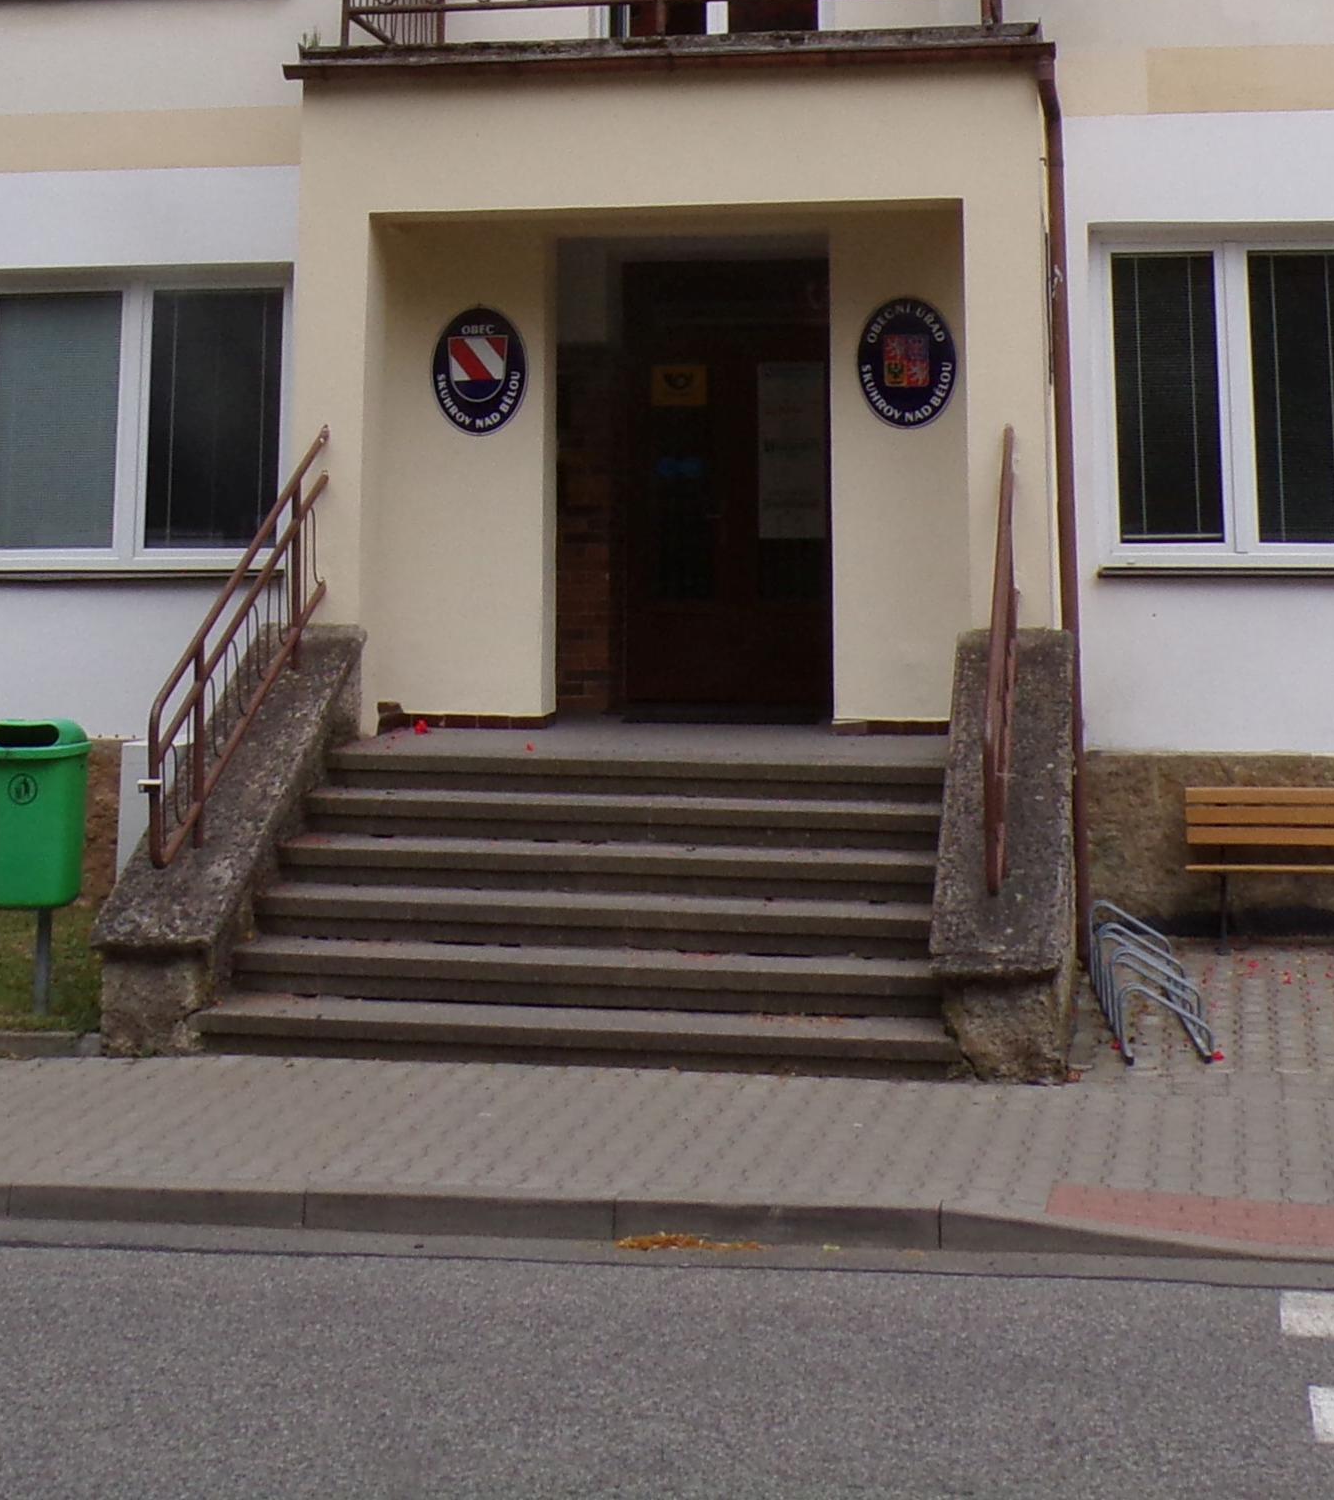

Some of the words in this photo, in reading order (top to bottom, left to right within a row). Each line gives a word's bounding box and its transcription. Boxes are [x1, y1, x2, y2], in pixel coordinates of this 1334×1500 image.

[461, 324, 495, 335] OBEC
[437, 374, 472, 425] SKUHROV
[475, 412, 501, 428] NAD
[861, 364, 902, 419] SKUHROV
[905, 406, 932, 422] NAD
